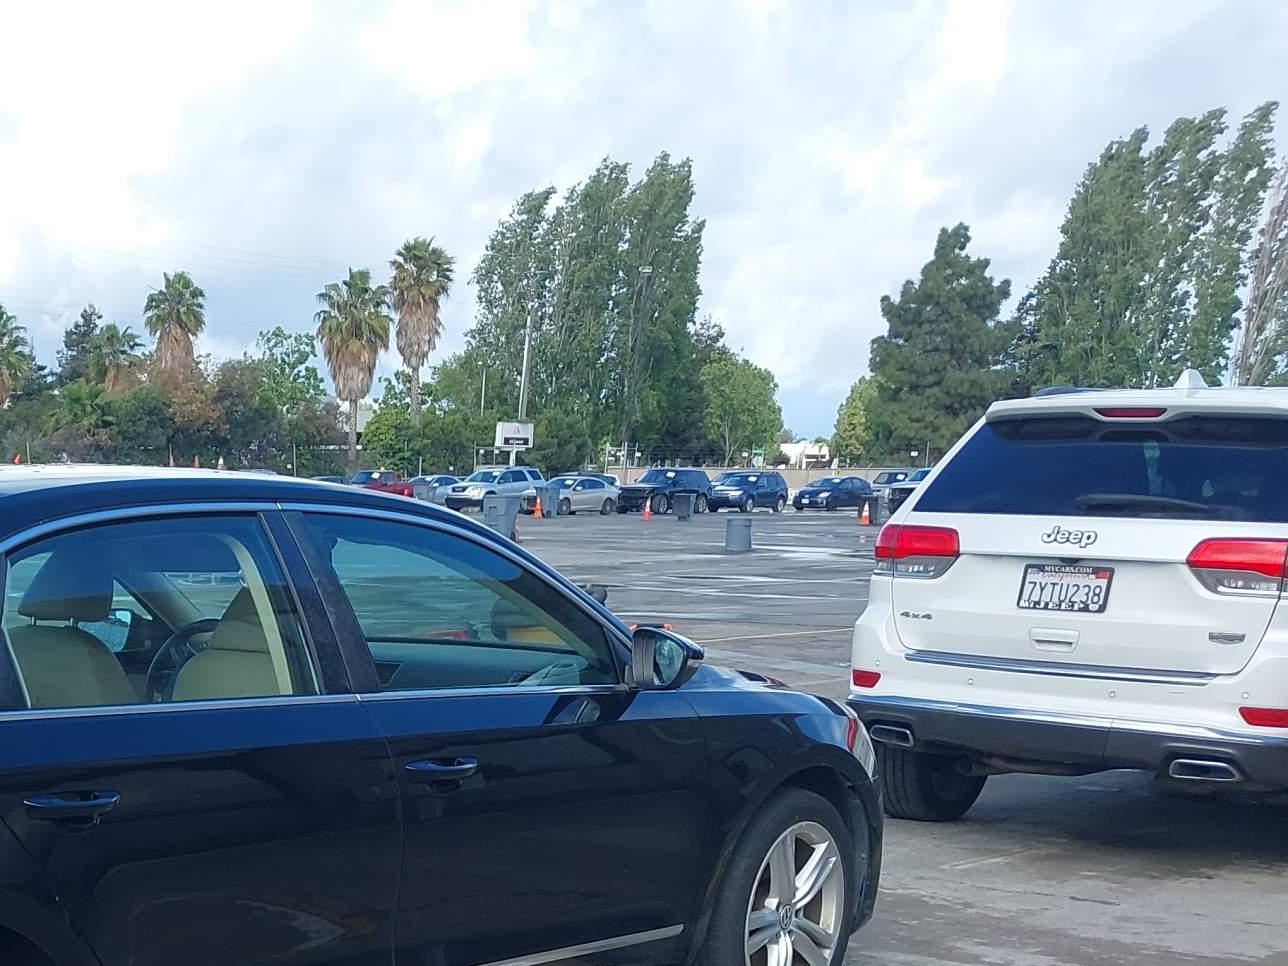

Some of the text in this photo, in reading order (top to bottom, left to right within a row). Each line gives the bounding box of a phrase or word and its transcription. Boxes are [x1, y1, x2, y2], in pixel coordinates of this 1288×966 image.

[1041, 525, 1098, 548] Jeep
[1027, 581, 1103, 604] 7YTU238
[1036, 601, 1085, 611] JEEP
